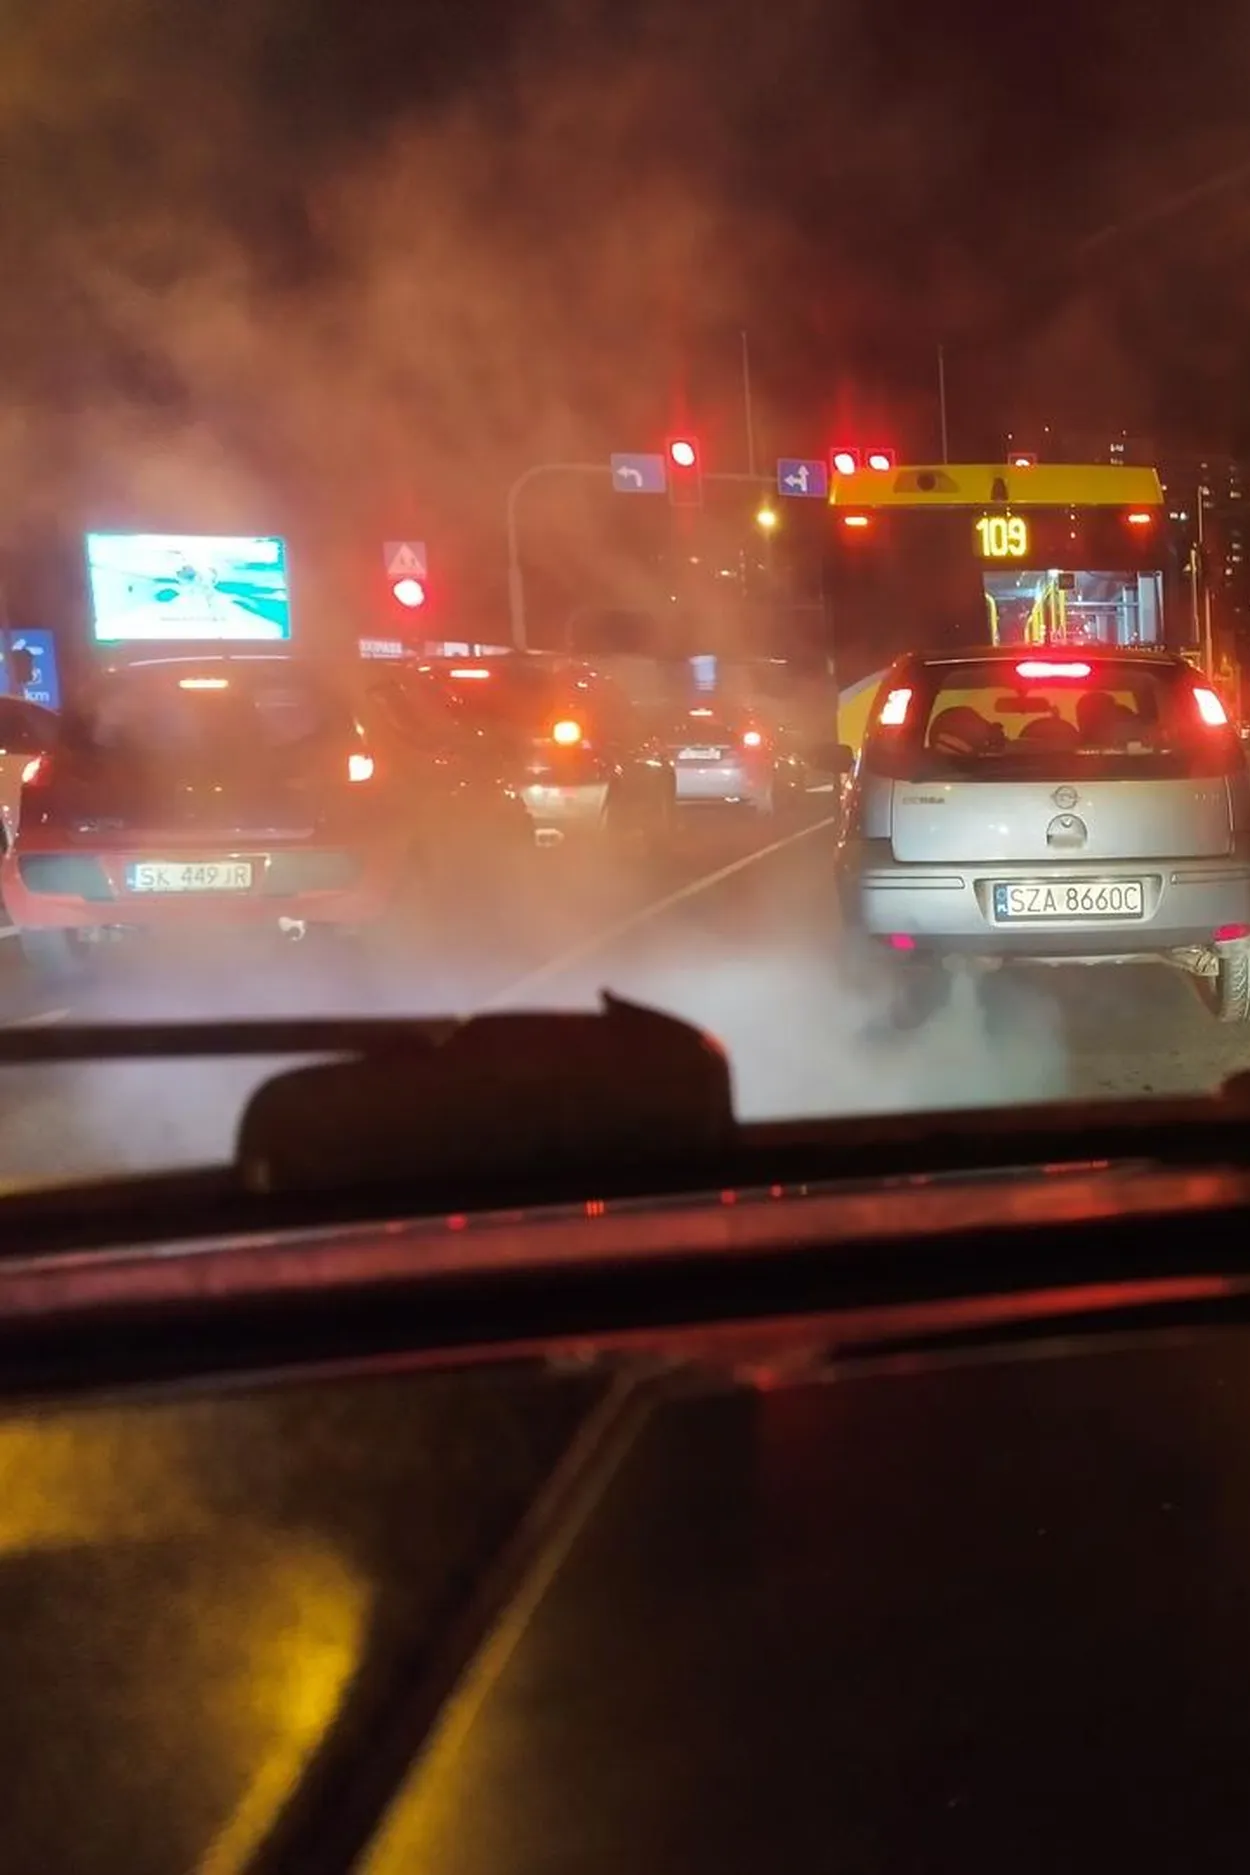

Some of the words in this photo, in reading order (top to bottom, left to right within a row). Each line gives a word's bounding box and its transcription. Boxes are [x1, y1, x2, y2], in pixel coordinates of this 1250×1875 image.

[975, 517, 1027, 556] 109
[140, 866, 170, 887] SK
[180, 865, 249, 887] 449JR
[1010, 887, 1058, 913] SZA
[1065, 886, 1139, 912] 8660C
